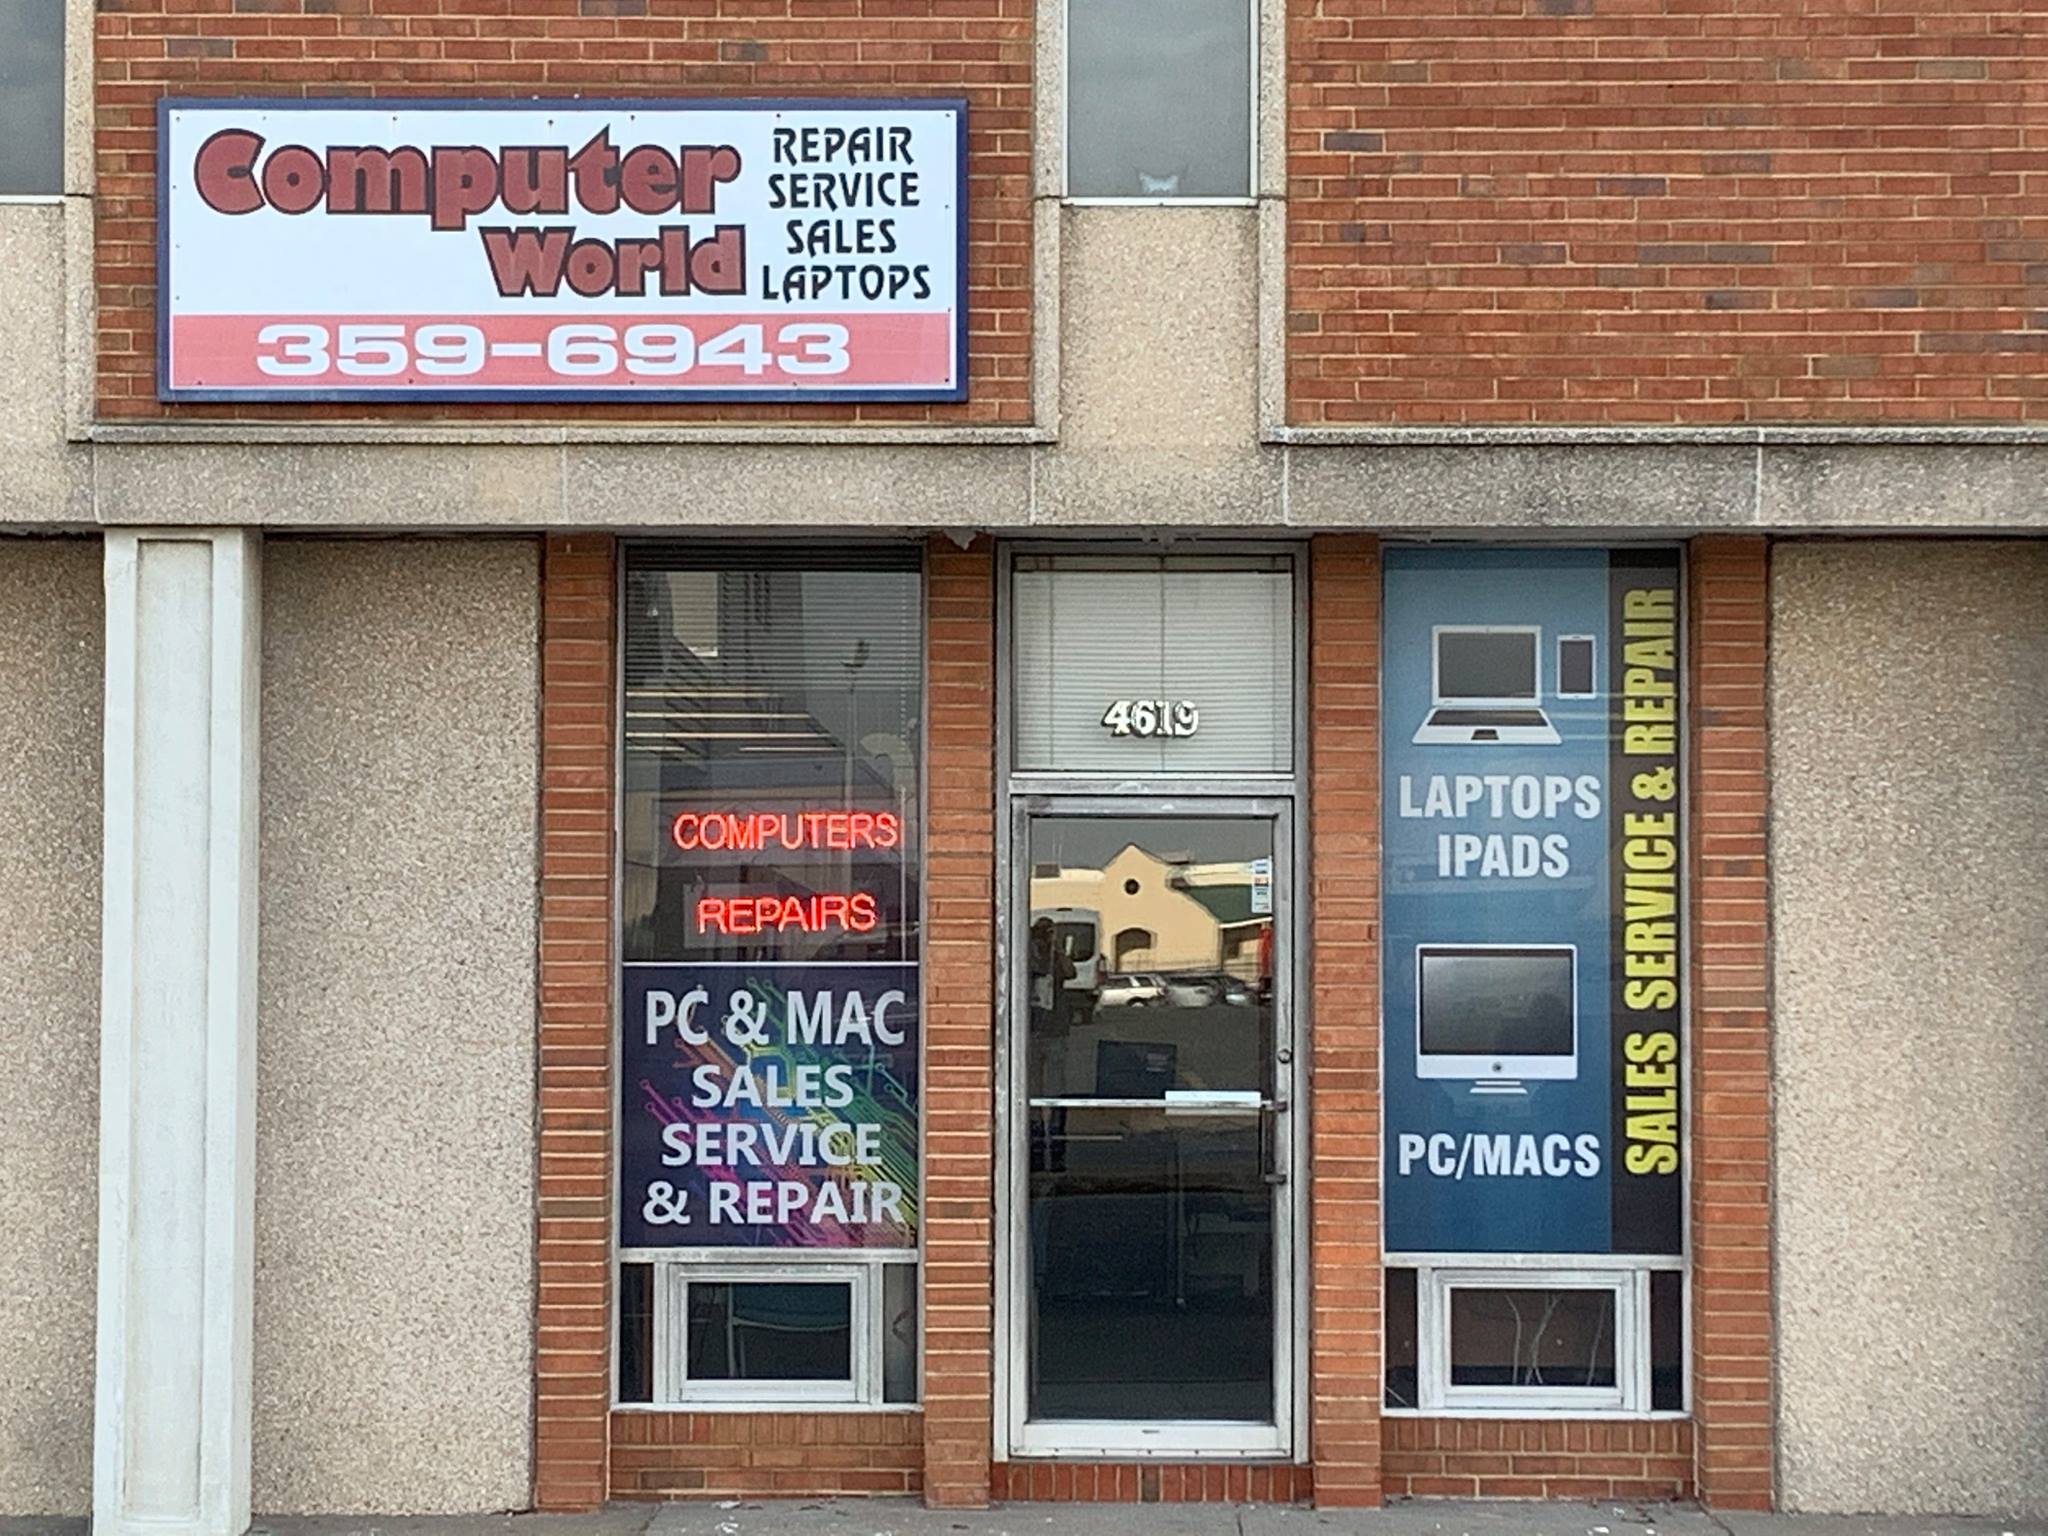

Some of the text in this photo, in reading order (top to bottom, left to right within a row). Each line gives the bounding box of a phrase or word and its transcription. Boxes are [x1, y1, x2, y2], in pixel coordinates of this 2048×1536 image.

[774, 126, 914, 167] REPAIR
[194, 125, 741, 231] Computer
[767, 172, 921, 212] SERVICE
[786, 218, 897, 255] SALES
[480, 224, 747, 298] World
[762, 264, 931, 303] LAPTOPS
[256, 323, 851, 376] 359-6943
[1102, 700, 1199, 738] 4619
[1400, 774, 1601, 820] LAPTOPS
[673, 811, 900, 850] COMPUTERS
[1437, 833, 1570, 879] IPADS
[1623, 588, 1679, 1175] SALES SERVICE & REPAIR
[697, 893, 878, 934] REPAIRS
[645, 990, 906, 1046] PC & MAC
[691, 1064, 854, 1108] SALES
[661, 1122, 882, 1167] SERVICE
[1398, 1132, 1601, 1181] PC/MACS
[642, 1180, 905, 1224] & REPAIR
